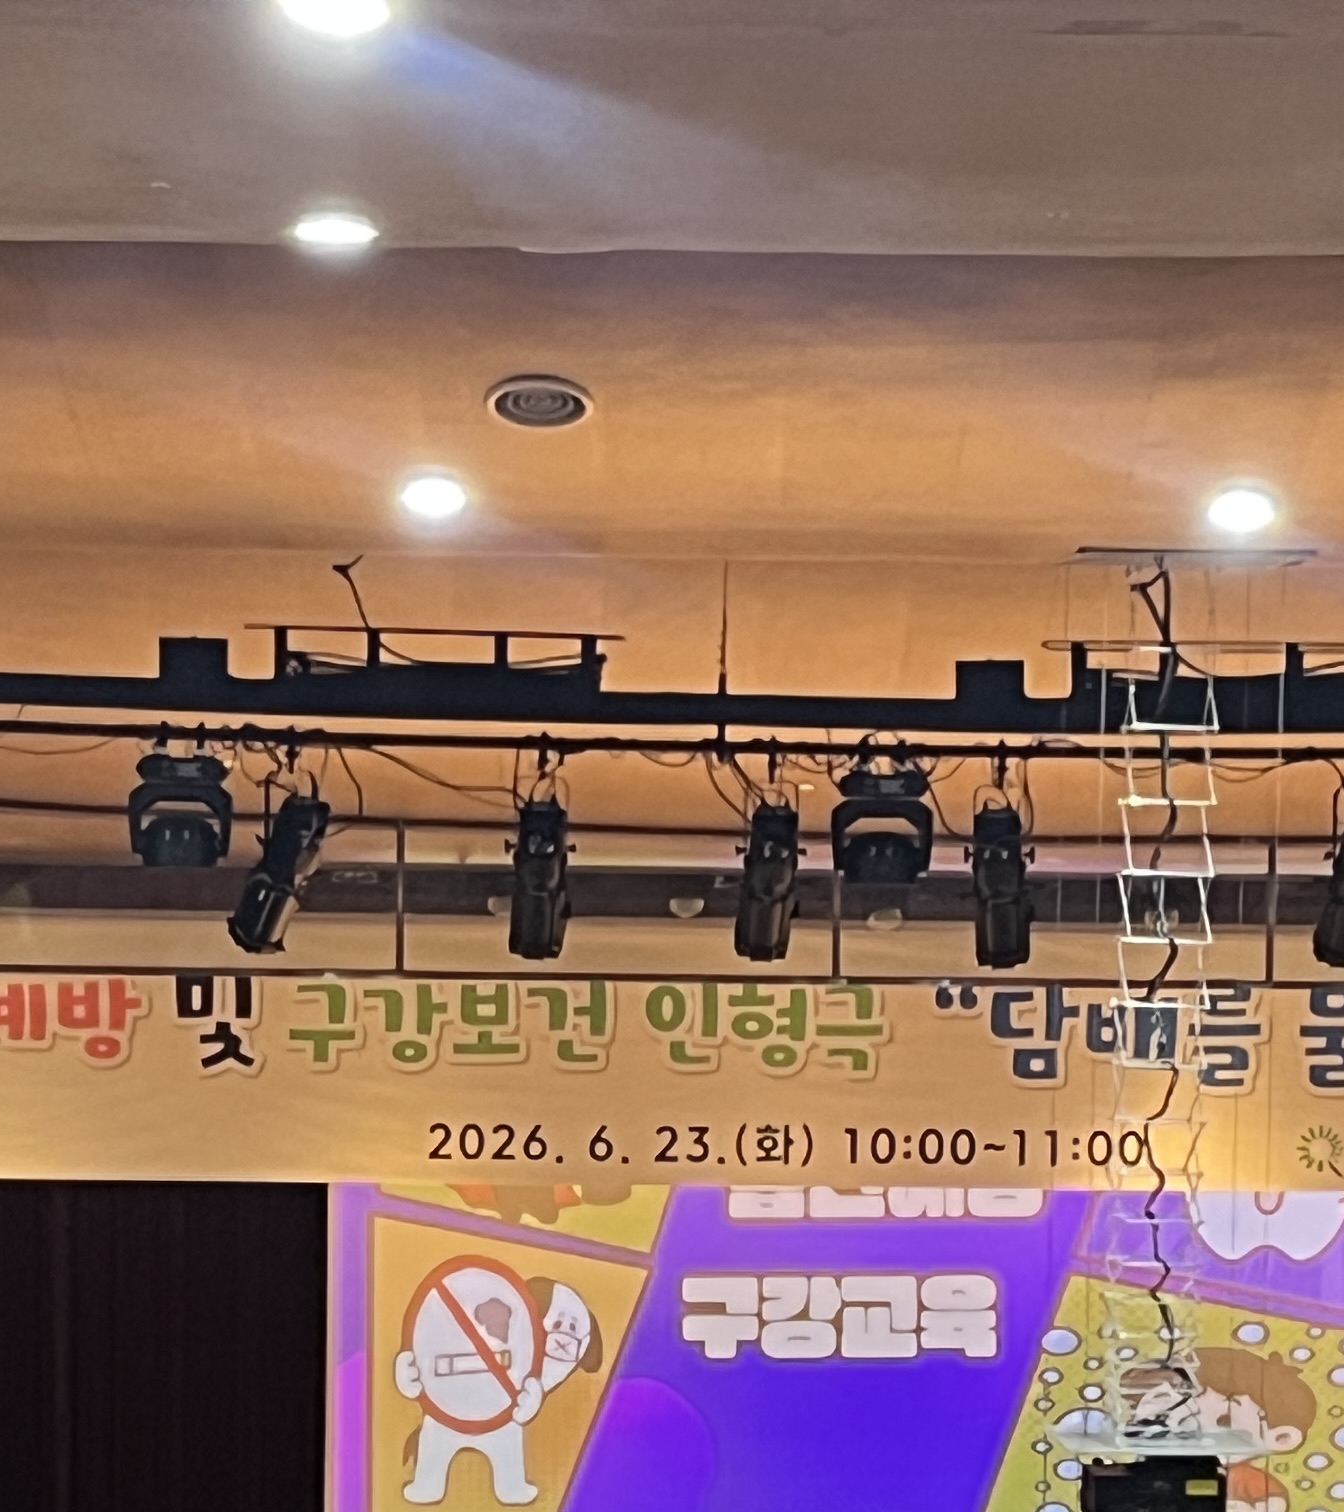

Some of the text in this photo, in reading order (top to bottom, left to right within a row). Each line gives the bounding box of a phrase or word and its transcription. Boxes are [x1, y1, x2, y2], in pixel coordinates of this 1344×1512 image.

[175, 975, 256, 1069] 및
[289, 981, 607, 1064] 구강보건
[645, 981, 885, 1071] 인형극
[427, 1123, 565, 1165] 2026.
[587, 1124, 631, 1165] 6.
[654, 1121, 815, 1169] 23.(화)
[844, 1125, 1146, 1169] 10:00~11:00
[681, 1274, 998, 1360] 구강교육
